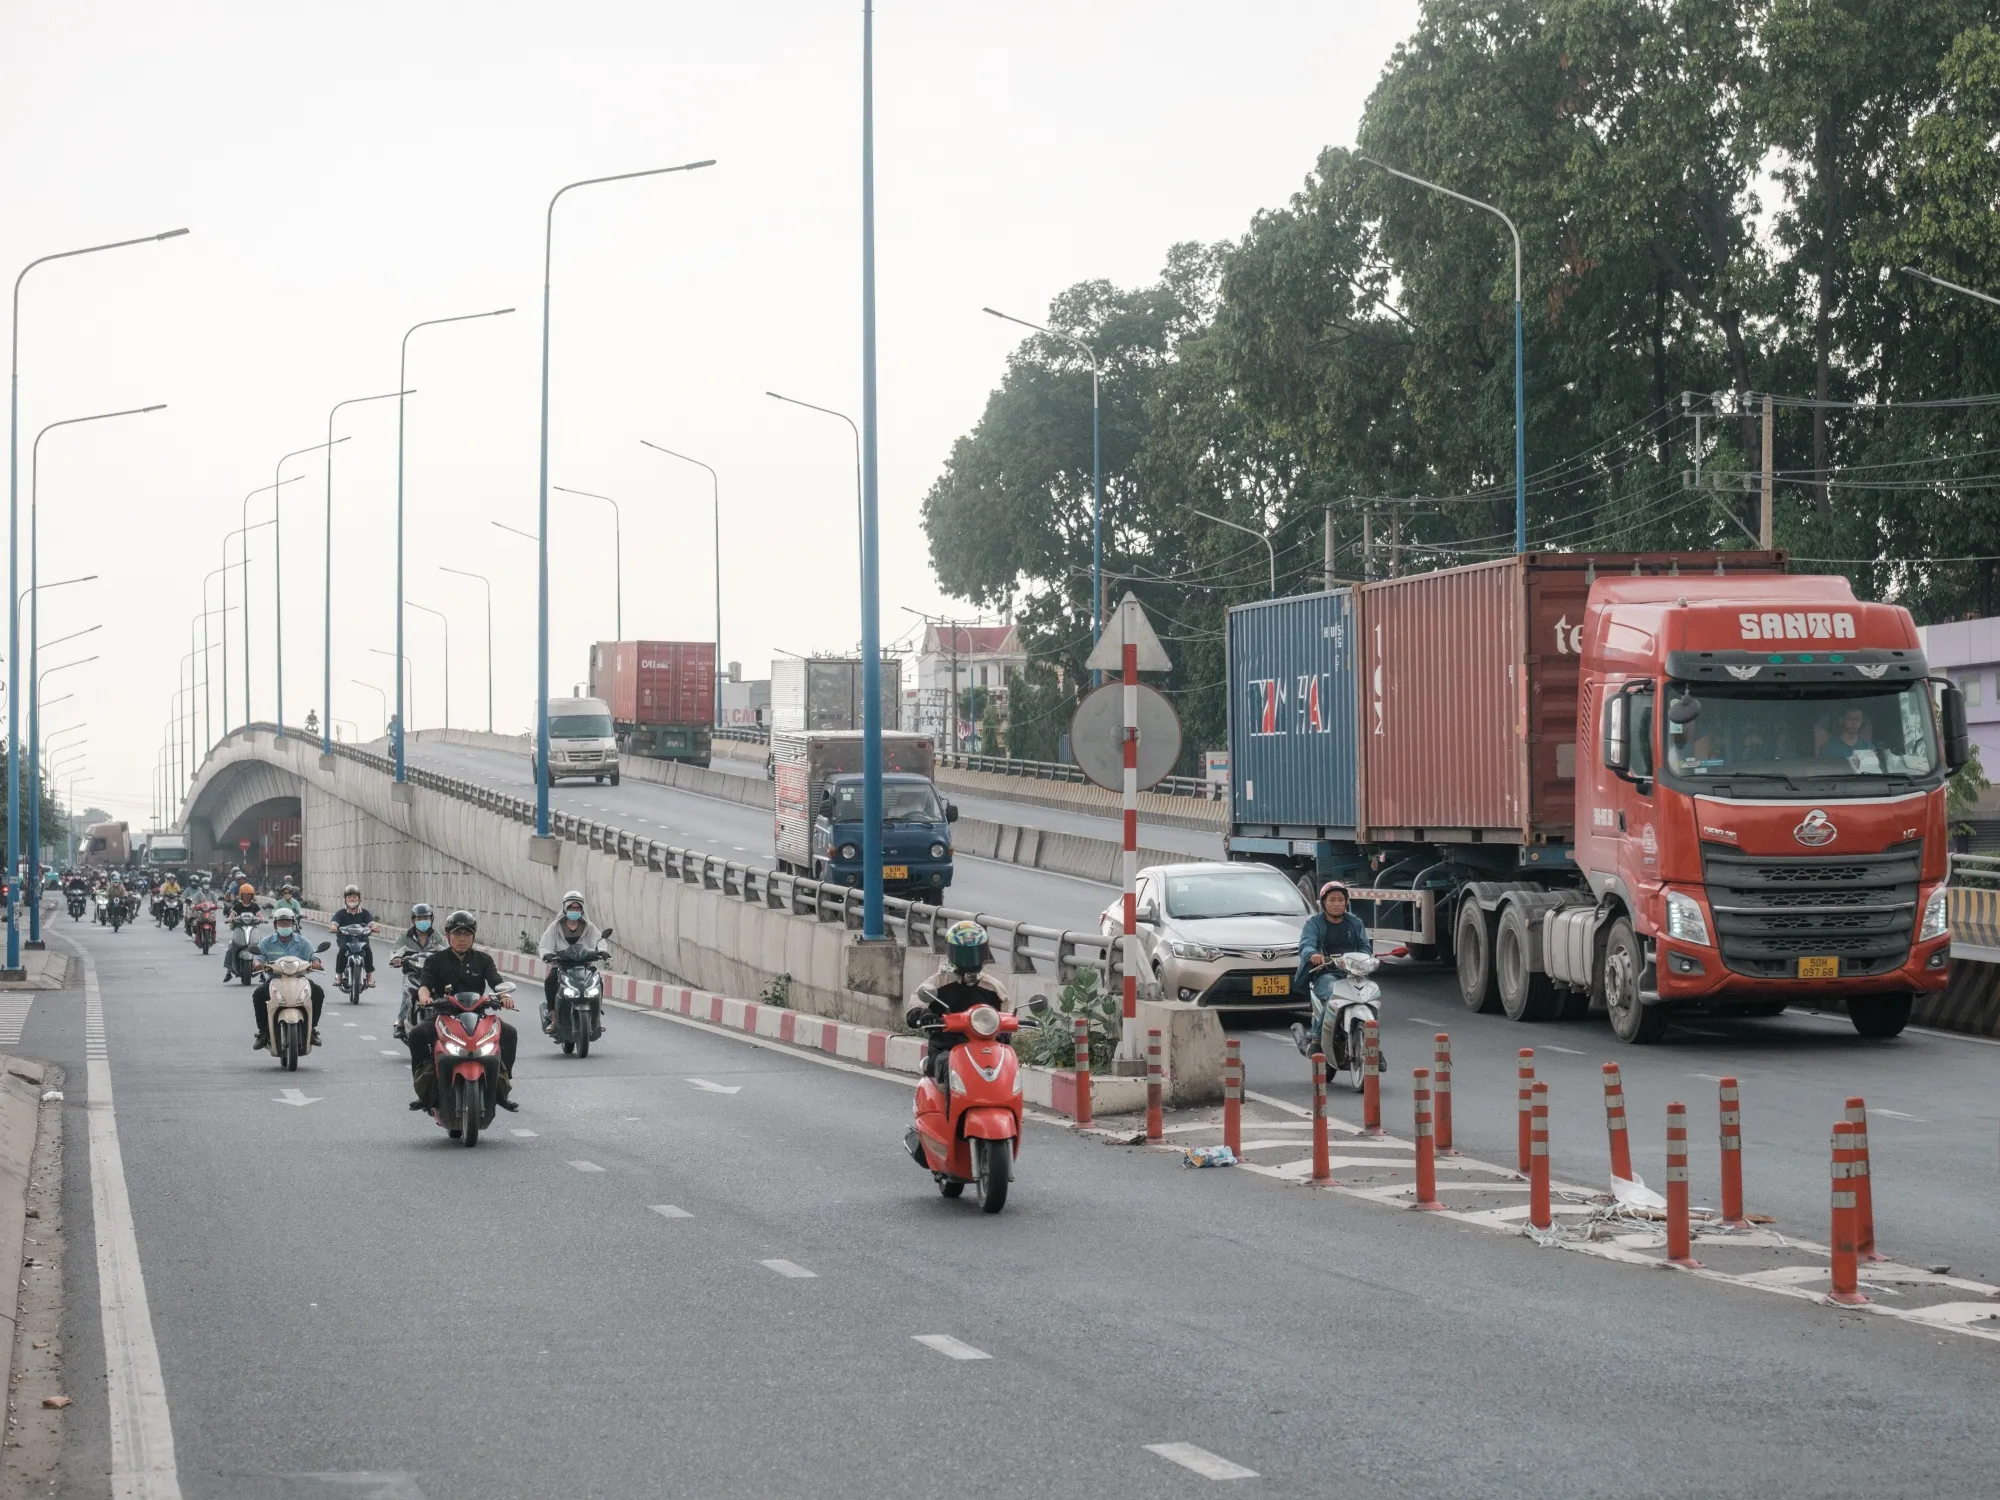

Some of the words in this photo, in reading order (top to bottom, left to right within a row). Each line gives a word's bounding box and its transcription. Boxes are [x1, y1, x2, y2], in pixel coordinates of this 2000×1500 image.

[1739, 613, 1856, 639] SANTA
[1802, 968, 1834, 977] 097.68
[1263, 977, 1280, 985] 51G
[1257, 986, 1286, 995] 210.75
